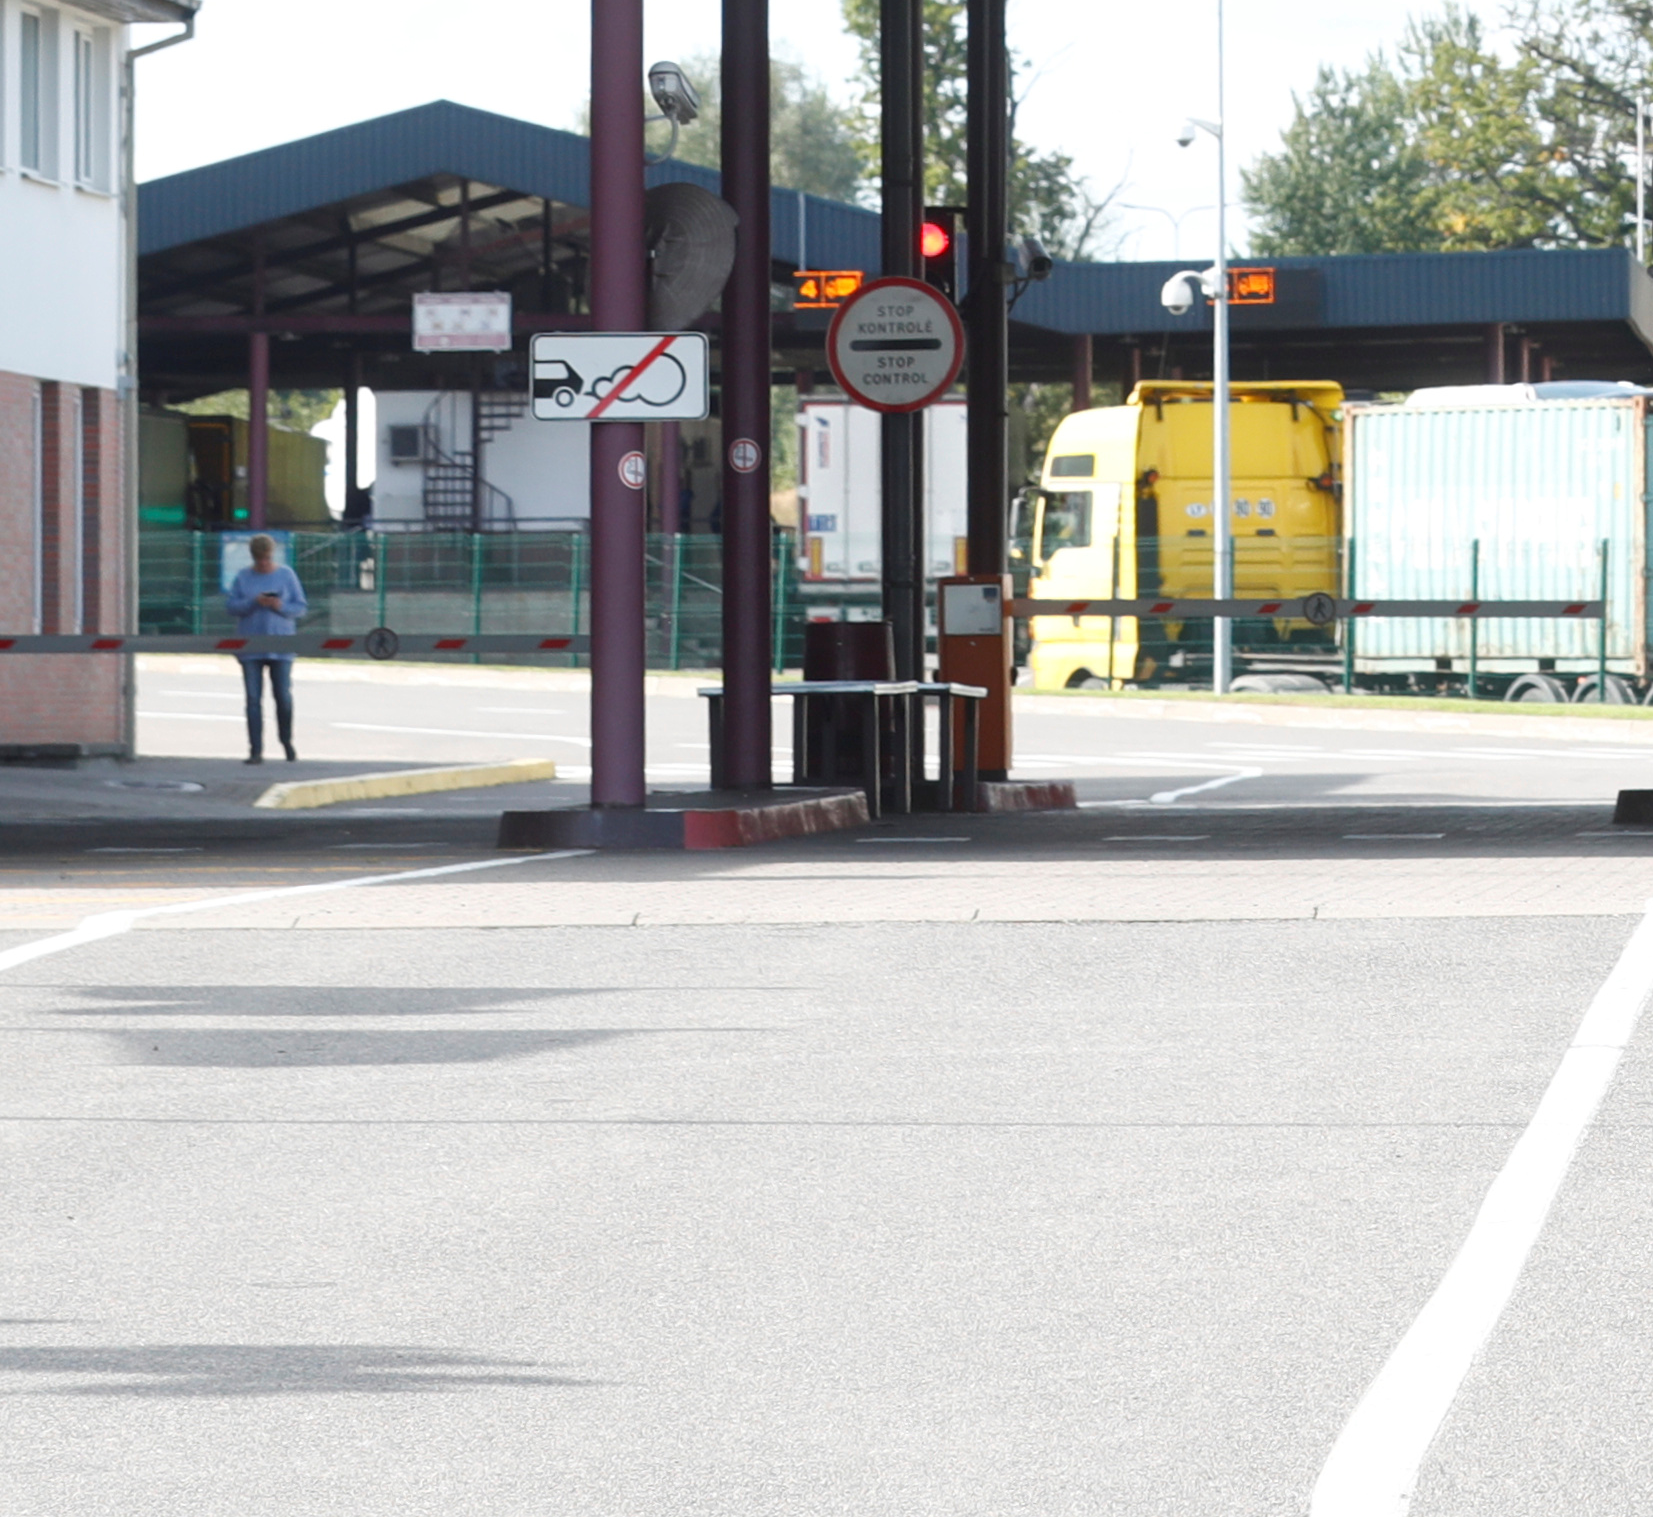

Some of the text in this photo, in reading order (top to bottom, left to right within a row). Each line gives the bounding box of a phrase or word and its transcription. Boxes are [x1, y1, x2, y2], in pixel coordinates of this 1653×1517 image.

[877, 305, 914, 317] STOP
[878, 356, 915, 368] STOP
[863, 373, 927, 385] CONTROL
